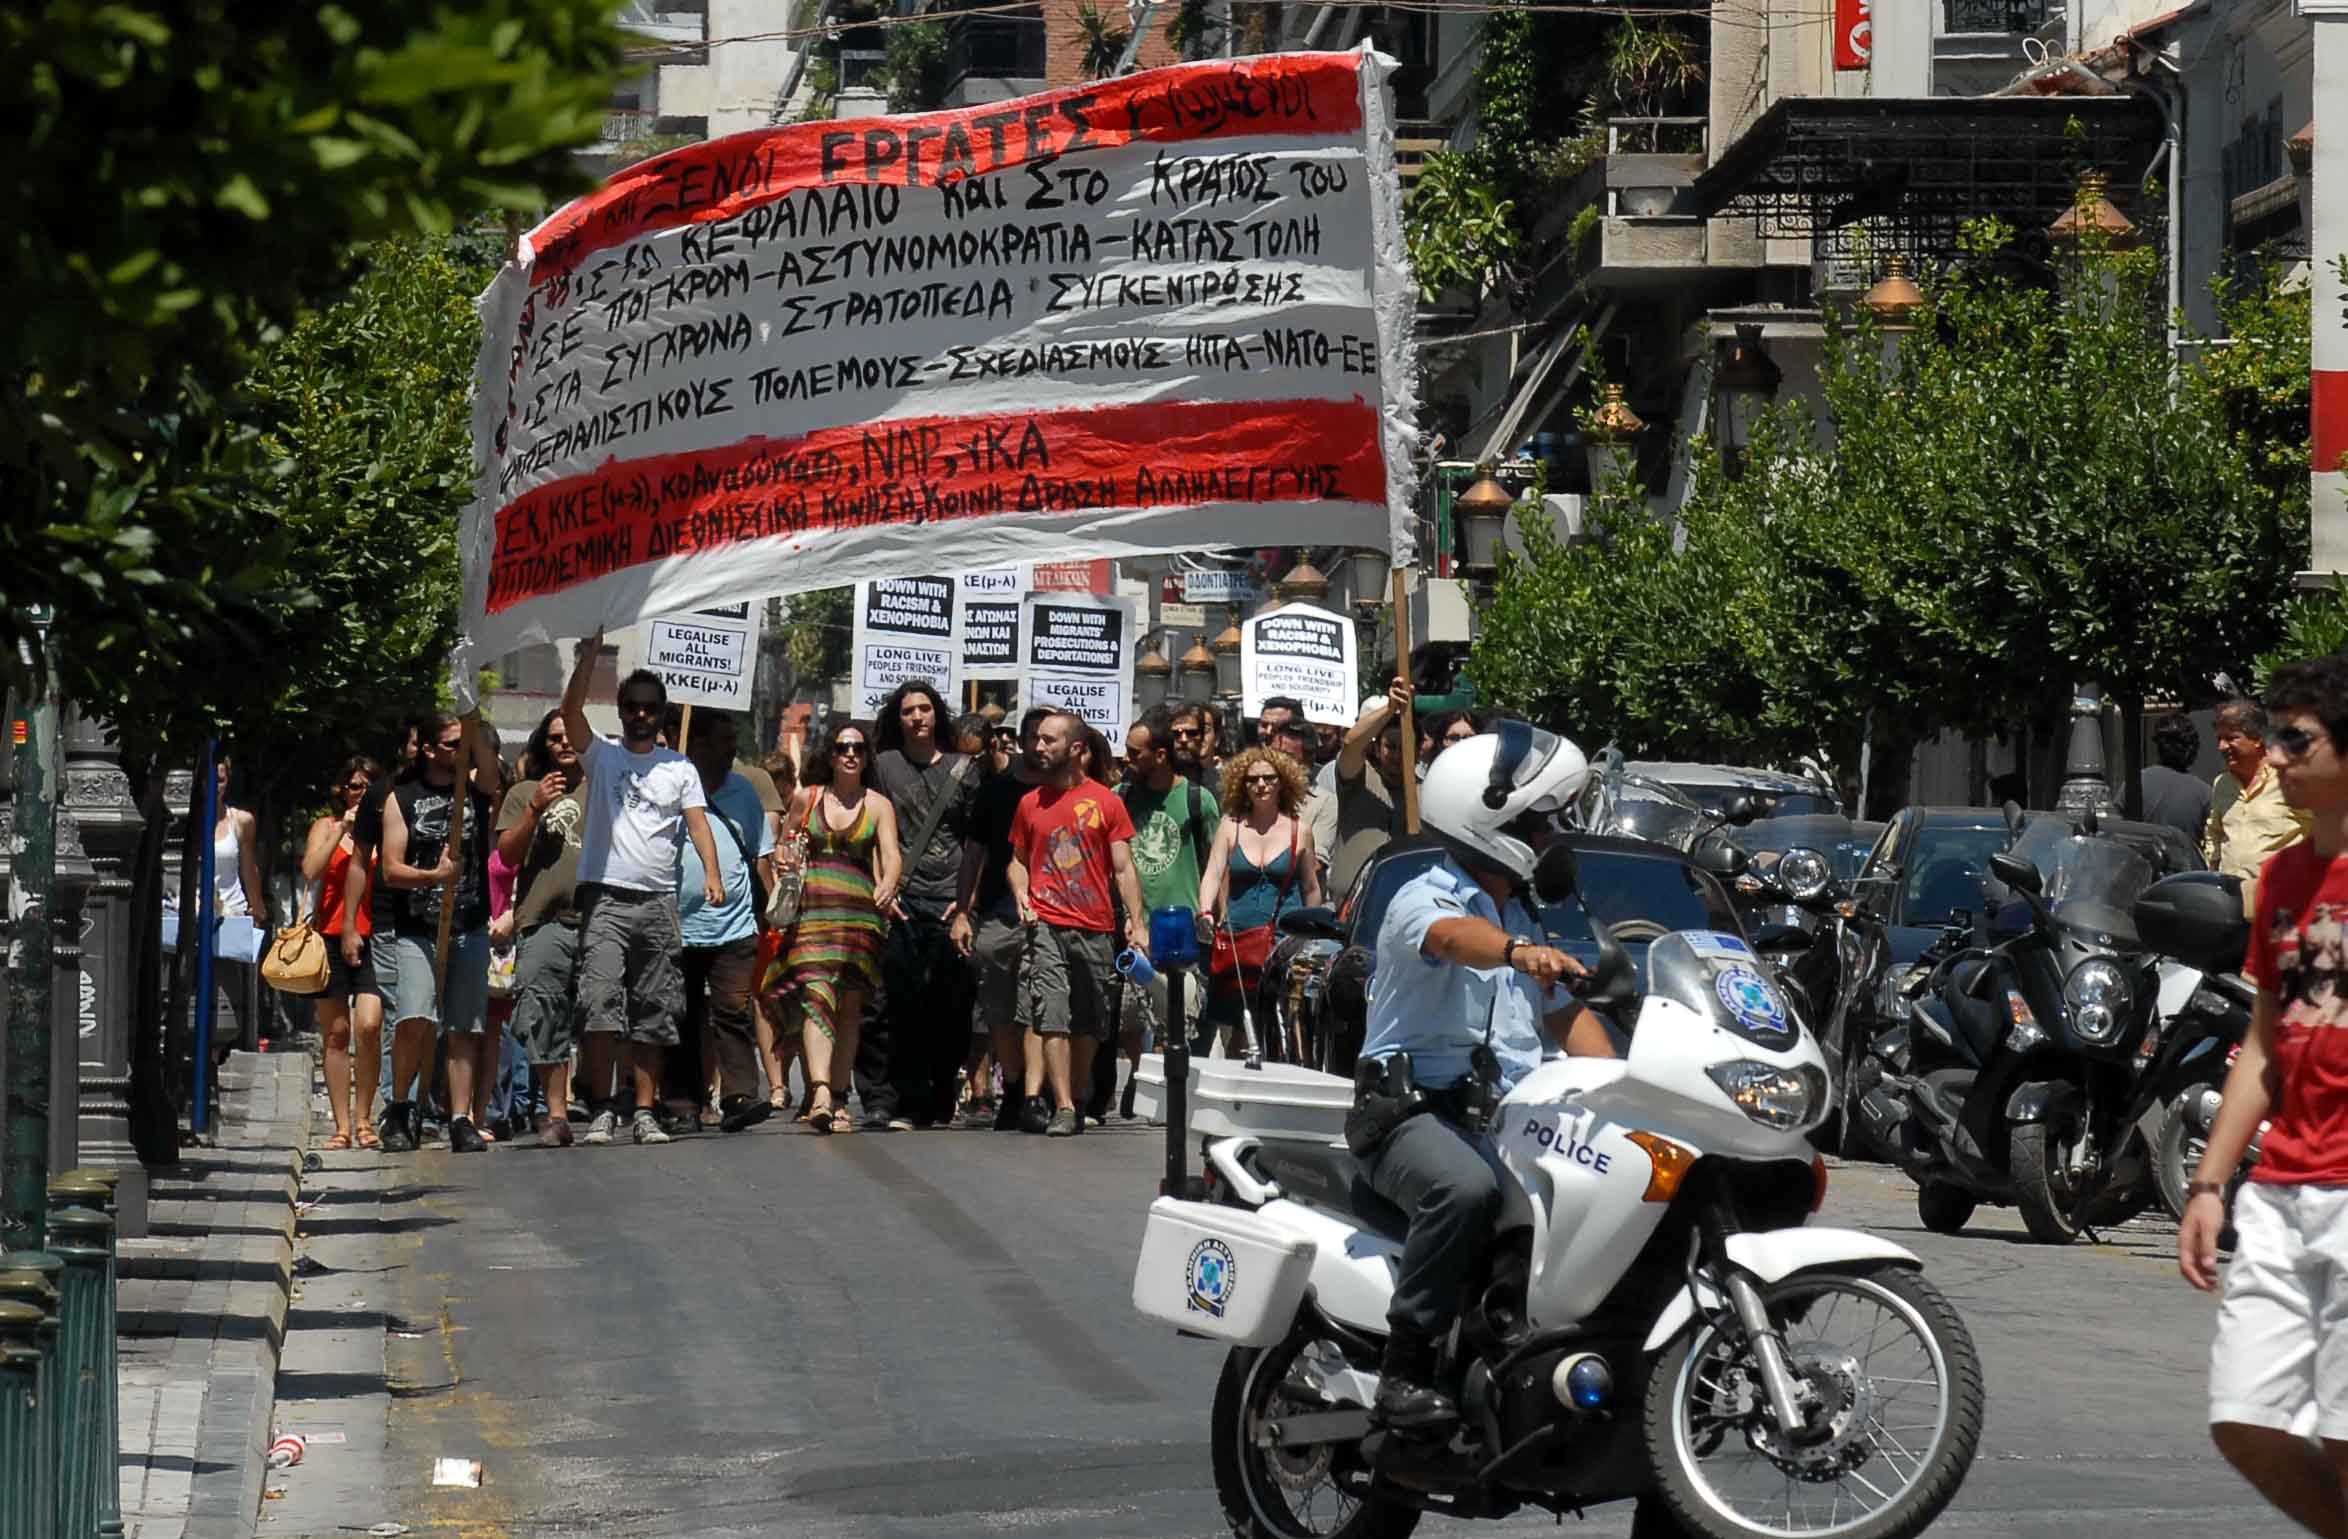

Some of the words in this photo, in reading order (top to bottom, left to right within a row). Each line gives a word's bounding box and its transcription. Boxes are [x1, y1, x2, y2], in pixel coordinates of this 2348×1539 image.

[821, 94, 1102, 183] ΕΡΓΑΤΕΣ
[681, 183, 900, 265] ΚΕΦΑΛΑΙΟ
[1151, 149, 1280, 206] ΚΡΑΤΟΣ
[533, 310, 587, 376] ΣΕ
[530, 369, 582, 430] ΣΤΑ
[600, 312, 753, 393] ΣΥΓΧΡΟΝΑ
[1018, 474, 1117, 512] ΔΡΑΣΗ
[1136, 463, 1352, 507] ΑΛΛΗΛΕΓΓΥΗΣ
[876, 578, 917, 596] DOWN
[918, 581, 947, 598] WITH
[881, 595, 929, 613] RACISM
[931, 601, 942, 614] &
[869, 610, 949, 631] XENOPHOBIA
[975, 609, 1017, 623] ΑΓΩΝΑΣ
[1048, 610, 1080, 625] DOWN
[1082, 612, 1106, 626] WITH
[992, 626, 1011, 639] ΚΑΙ
[1261, 618, 1302, 631] DOWN
[1304, 619, 1337, 635] WITH
[668, 628, 731, 646] LEGALISE
[1034, 637, 1108, 651] PROSECUTIONS
[1110, 641, 1118, 651] &
[1267, 629, 1319, 644] RACISM
[1319, 633, 1332, 645] &
[685, 642, 709, 655] ALL
[876, 648, 911, 660] LONG
[915, 651, 942, 663] LIVE
[1038, 649, 1114, 664] DEPORTATIONS!
[1257, 640, 1342, 659] XENOPHOBIA
[659, 651, 732, 670] MIGRANTS!
[905, 662, 948, 676] FRIENDSHIP
[1266, 664, 1302, 673] LONG
[1307, 668, 1334, 678] LIVE
[880, 673, 895, 683] AND
[1047, 684, 1105, 697] LEGALISE
[1064, 696, 1087, 707] ALL
[1522, 1118, 1612, 1174] POLICE
